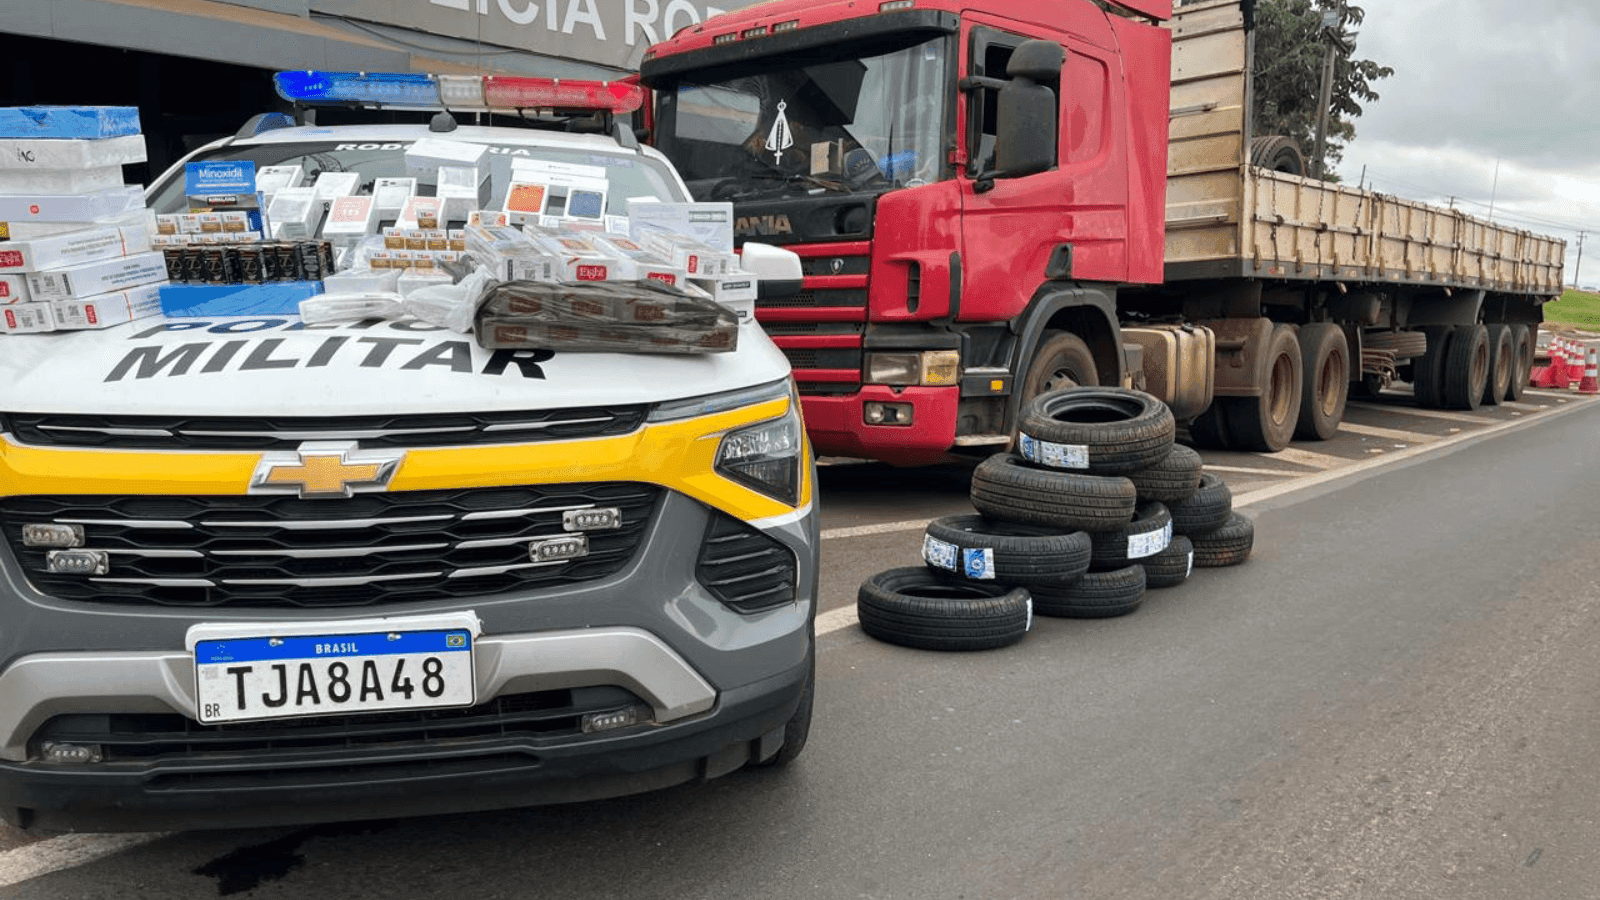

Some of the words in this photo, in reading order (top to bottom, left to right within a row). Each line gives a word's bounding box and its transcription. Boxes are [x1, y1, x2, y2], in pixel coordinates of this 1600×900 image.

[199, 168, 242, 178] Minoxidil
[734, 214, 793, 235] ANIA
[103, 336, 555, 382] MILITAR
[315, 642, 359, 654] BRASIL
[227, 656, 445, 710] TJA8A48
[205, 704, 221, 718] BR
